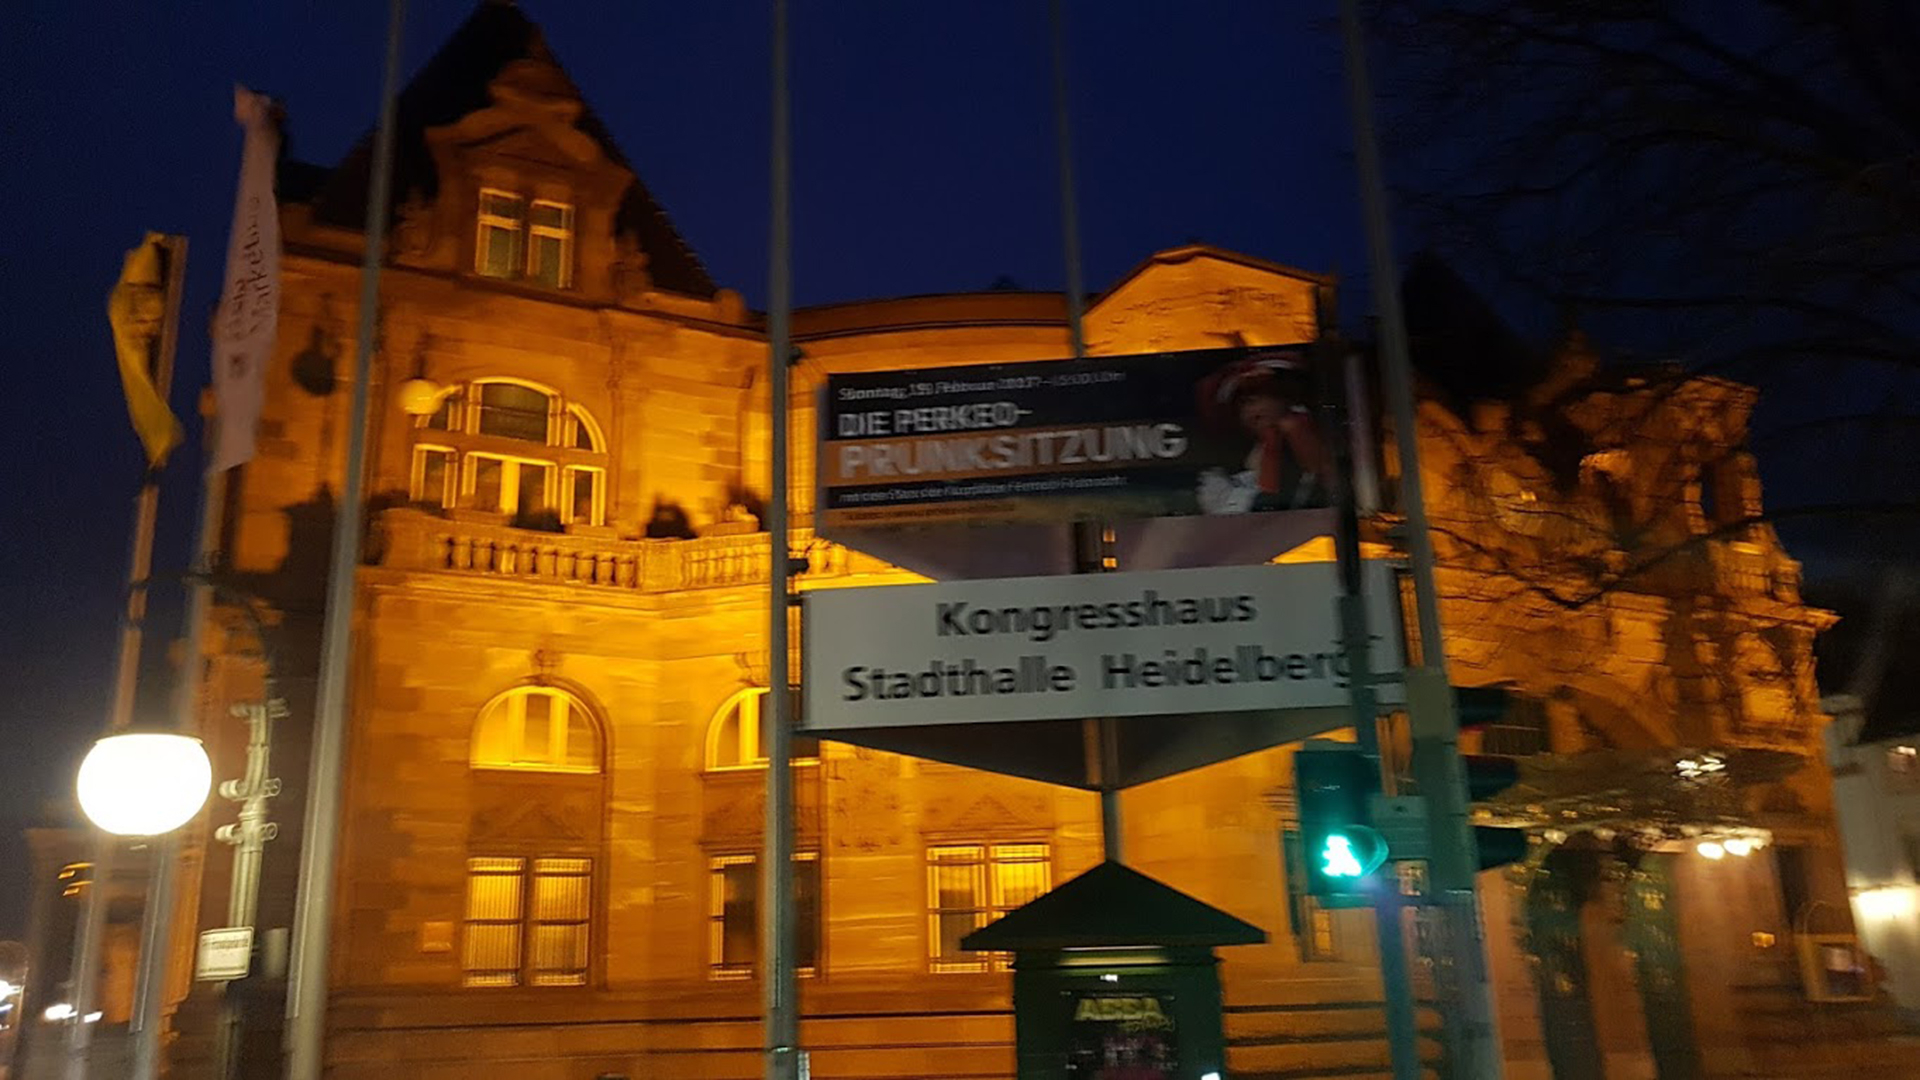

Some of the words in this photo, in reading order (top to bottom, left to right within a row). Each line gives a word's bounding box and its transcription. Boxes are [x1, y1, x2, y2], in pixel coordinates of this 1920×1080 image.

[839, 411, 892, 437] DIE
[895, 402, 1034, 433] PERKEO-
[839, 423, 1187, 478] PRUNKSITZUNG
[936, 589, 1257, 642] Kongresshaus
[843, 656, 1076, 703] Stadthalle
[1101, 645, 1351, 690] Heidelberg
